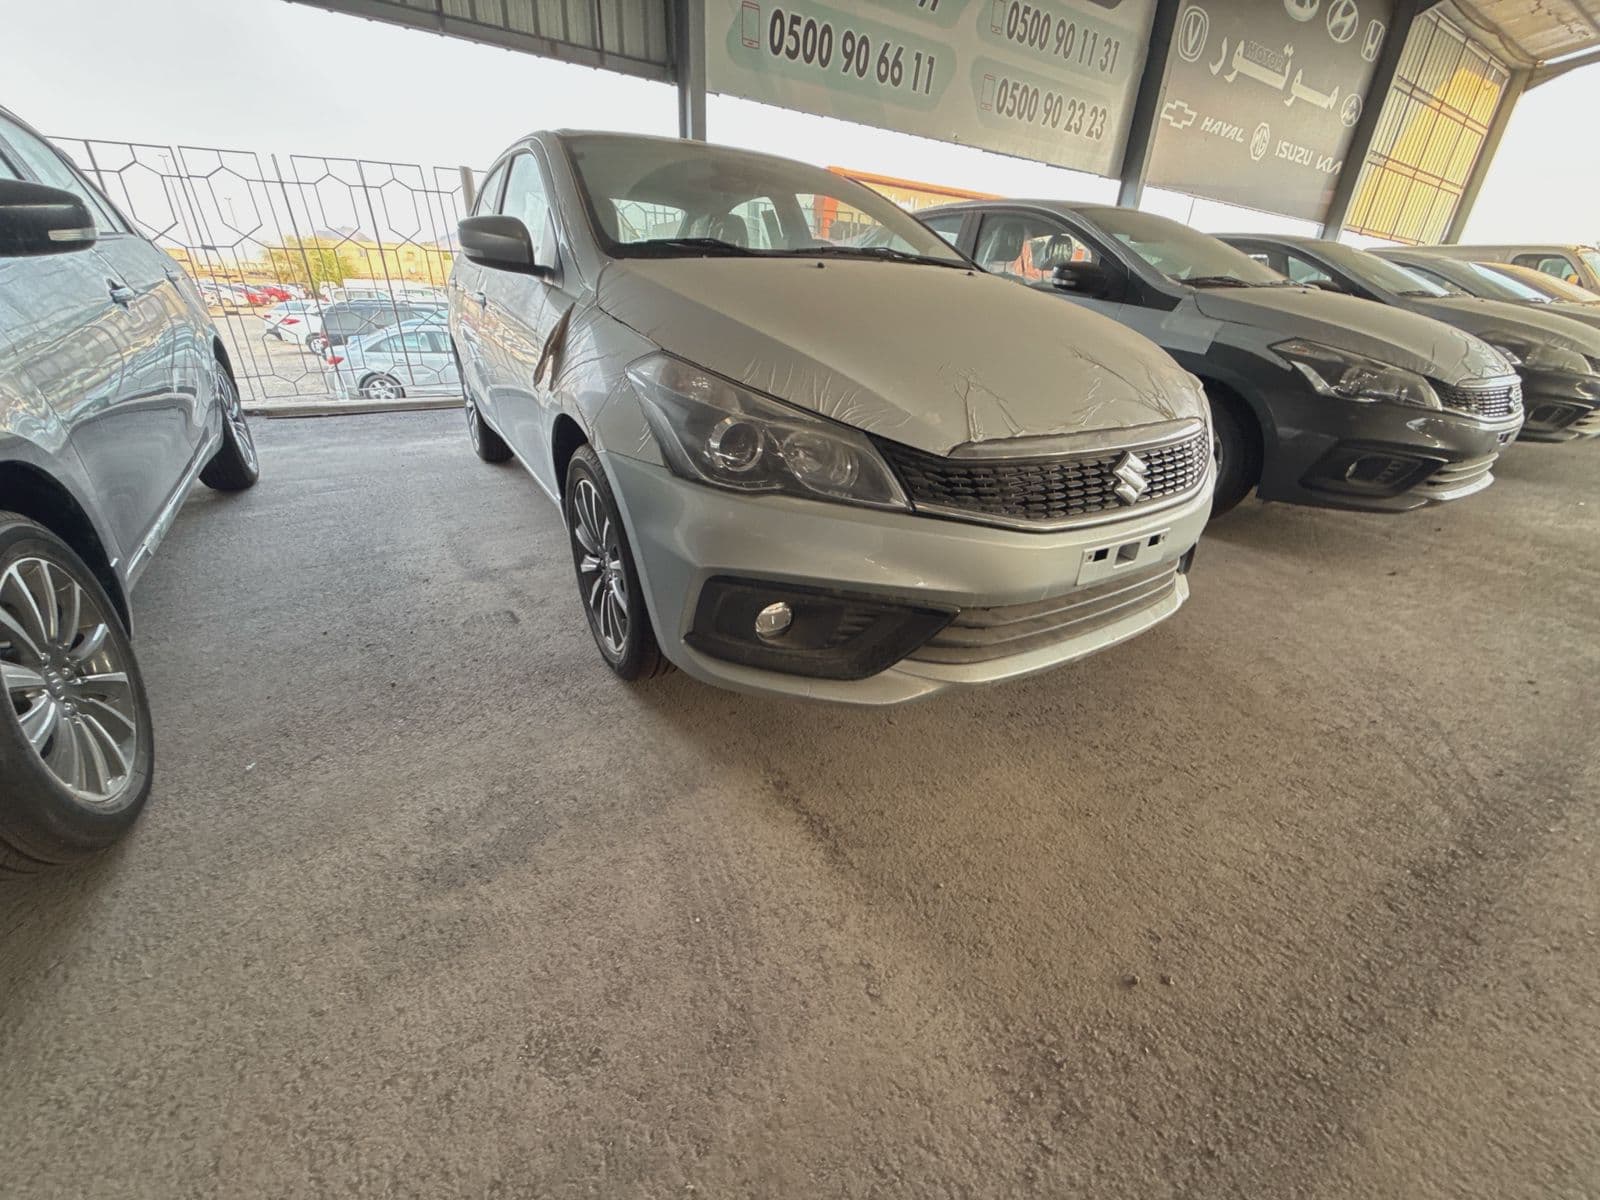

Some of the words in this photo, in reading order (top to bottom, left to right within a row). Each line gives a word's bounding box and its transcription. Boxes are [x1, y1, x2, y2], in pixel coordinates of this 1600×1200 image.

[769, 8, 834, 68] 0500
[841, 31, 871, 78] 90
[876, 42, 905, 88] 66
[911, 52, 936, 95] 11
[1007, 1, 1051, 51] 0500
[1055, 24, 1075, 60] 90
[1079, 29, 1099, 68] 11
[1101, 39, 1121, 74] 31
[996, 79, 1038, 123] 0500
[1041, 95, 1063, 129] 90
[1064, 102, 1085, 137] 23
[1086, 106, 1107, 140] 23
[1201, 117, 1244, 143] HAVAL
[1275, 139, 1314, 166] ISUZU
